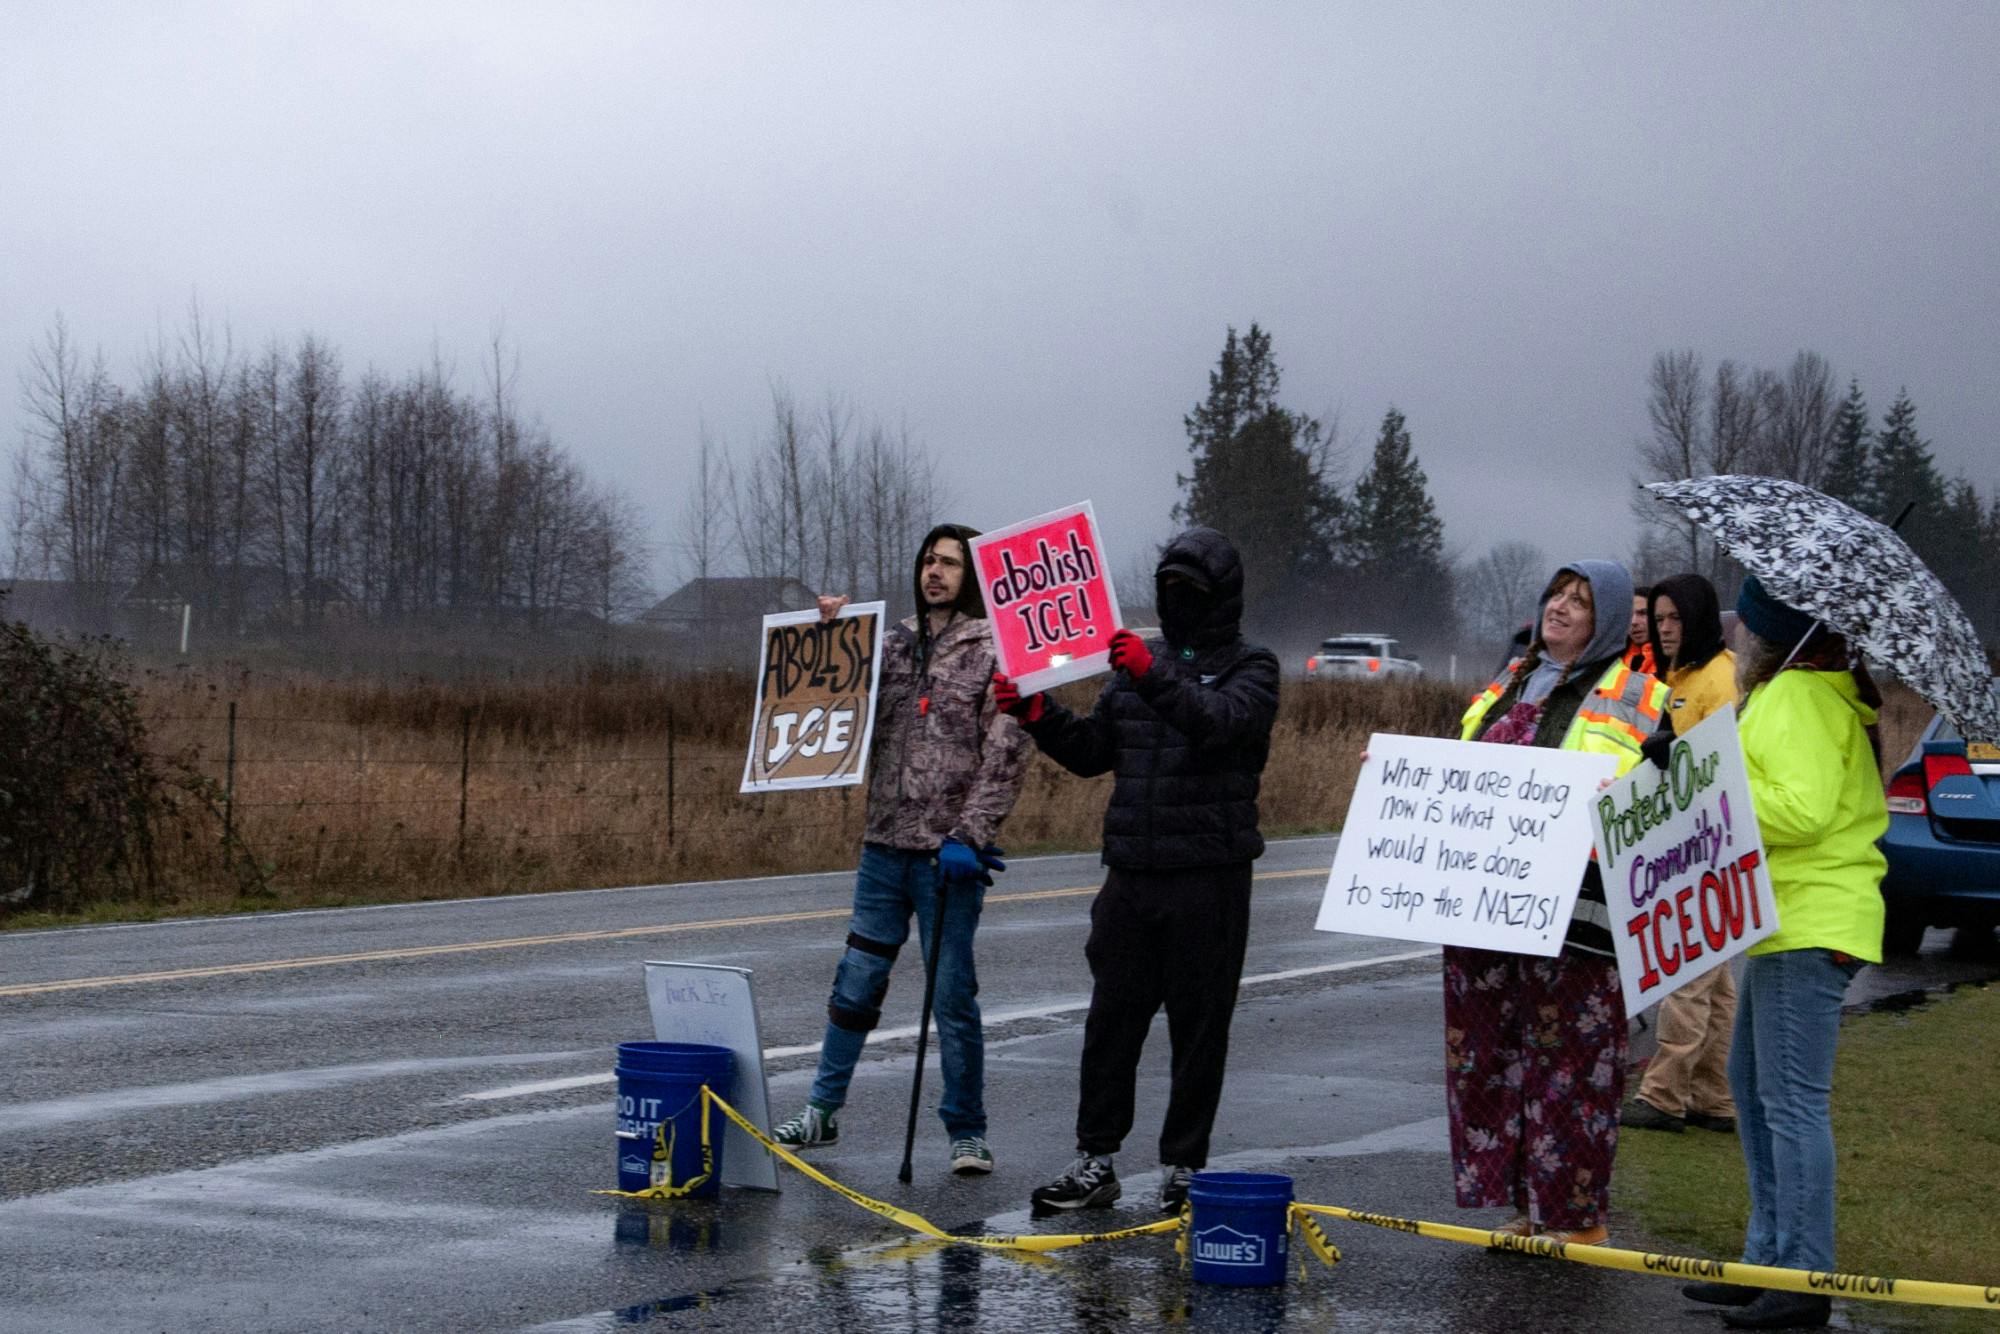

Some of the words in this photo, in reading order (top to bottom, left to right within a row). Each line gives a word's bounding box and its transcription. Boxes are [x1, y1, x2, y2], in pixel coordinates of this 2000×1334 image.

[992, 532, 1097, 606] abolish
[1018, 587, 1095, 651] ICE!
[761, 613, 878, 703] ABOLISH
[767, 706, 855, 764] ICE
[1381, 757, 1432, 790] What
[1436, 768, 1471, 795] you
[1518, 767, 1571, 820] doing
[1597, 771, 1672, 869] Protect
[1670, 740, 1720, 811] Our
[1380, 796, 1419, 820] now
[1424, 797, 1443, 823] is
[1507, 815, 1547, 845] you
[1367, 834, 1428, 865] would
[1435, 839, 1479, 872] have
[1483, 846, 1532, 880] done
[1629, 790, 1732, 908] Community!
[1346, 874, 1372, 906] to
[1380, 882, 1424, 922] stop
[1434, 885, 1464, 918] the
[1472, 886, 1560, 941] NAZIS!
[639, 1096, 663, 1119] IT
[1196, 1237, 1258, 1262] LOWE'S
[1491, 1231, 1567, 1259] CAUTION
[1643, 1253, 1725, 1278] CAUTION
[1807, 1269, 1896, 1295] CAUTION
[1984, 1285, 2000, 1305] C
